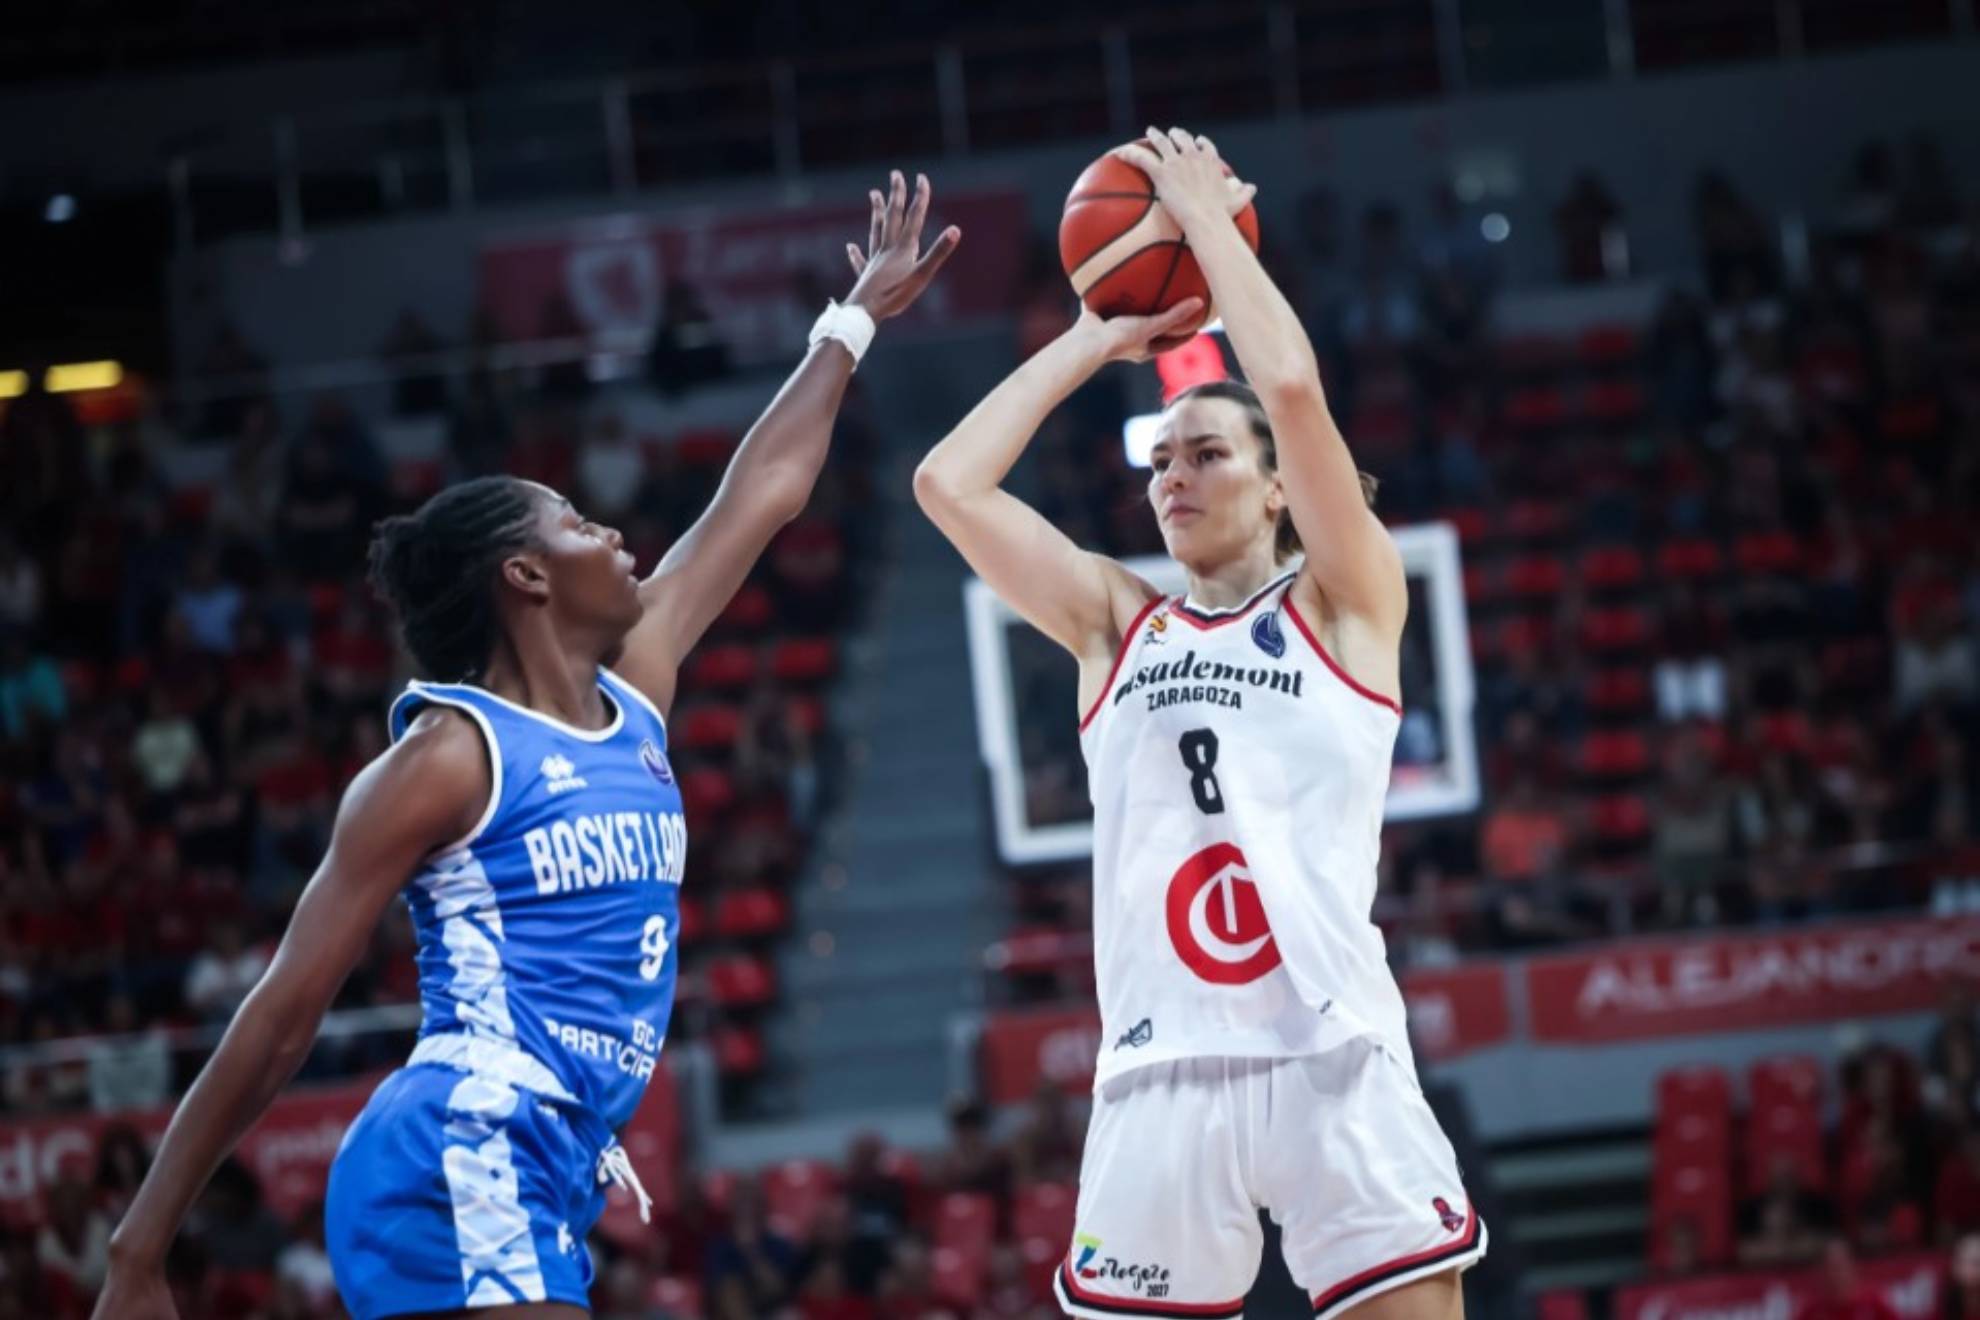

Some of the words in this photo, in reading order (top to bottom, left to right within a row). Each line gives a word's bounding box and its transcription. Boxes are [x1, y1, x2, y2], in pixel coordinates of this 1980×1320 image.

[1114, 650, 1304, 707] sademont
[1146, 686, 1243, 712] ZARAGOZA
[1178, 727, 1225, 815] 8
[523, 811, 648, 895] BASKET
[639, 915, 669, 981] 9
